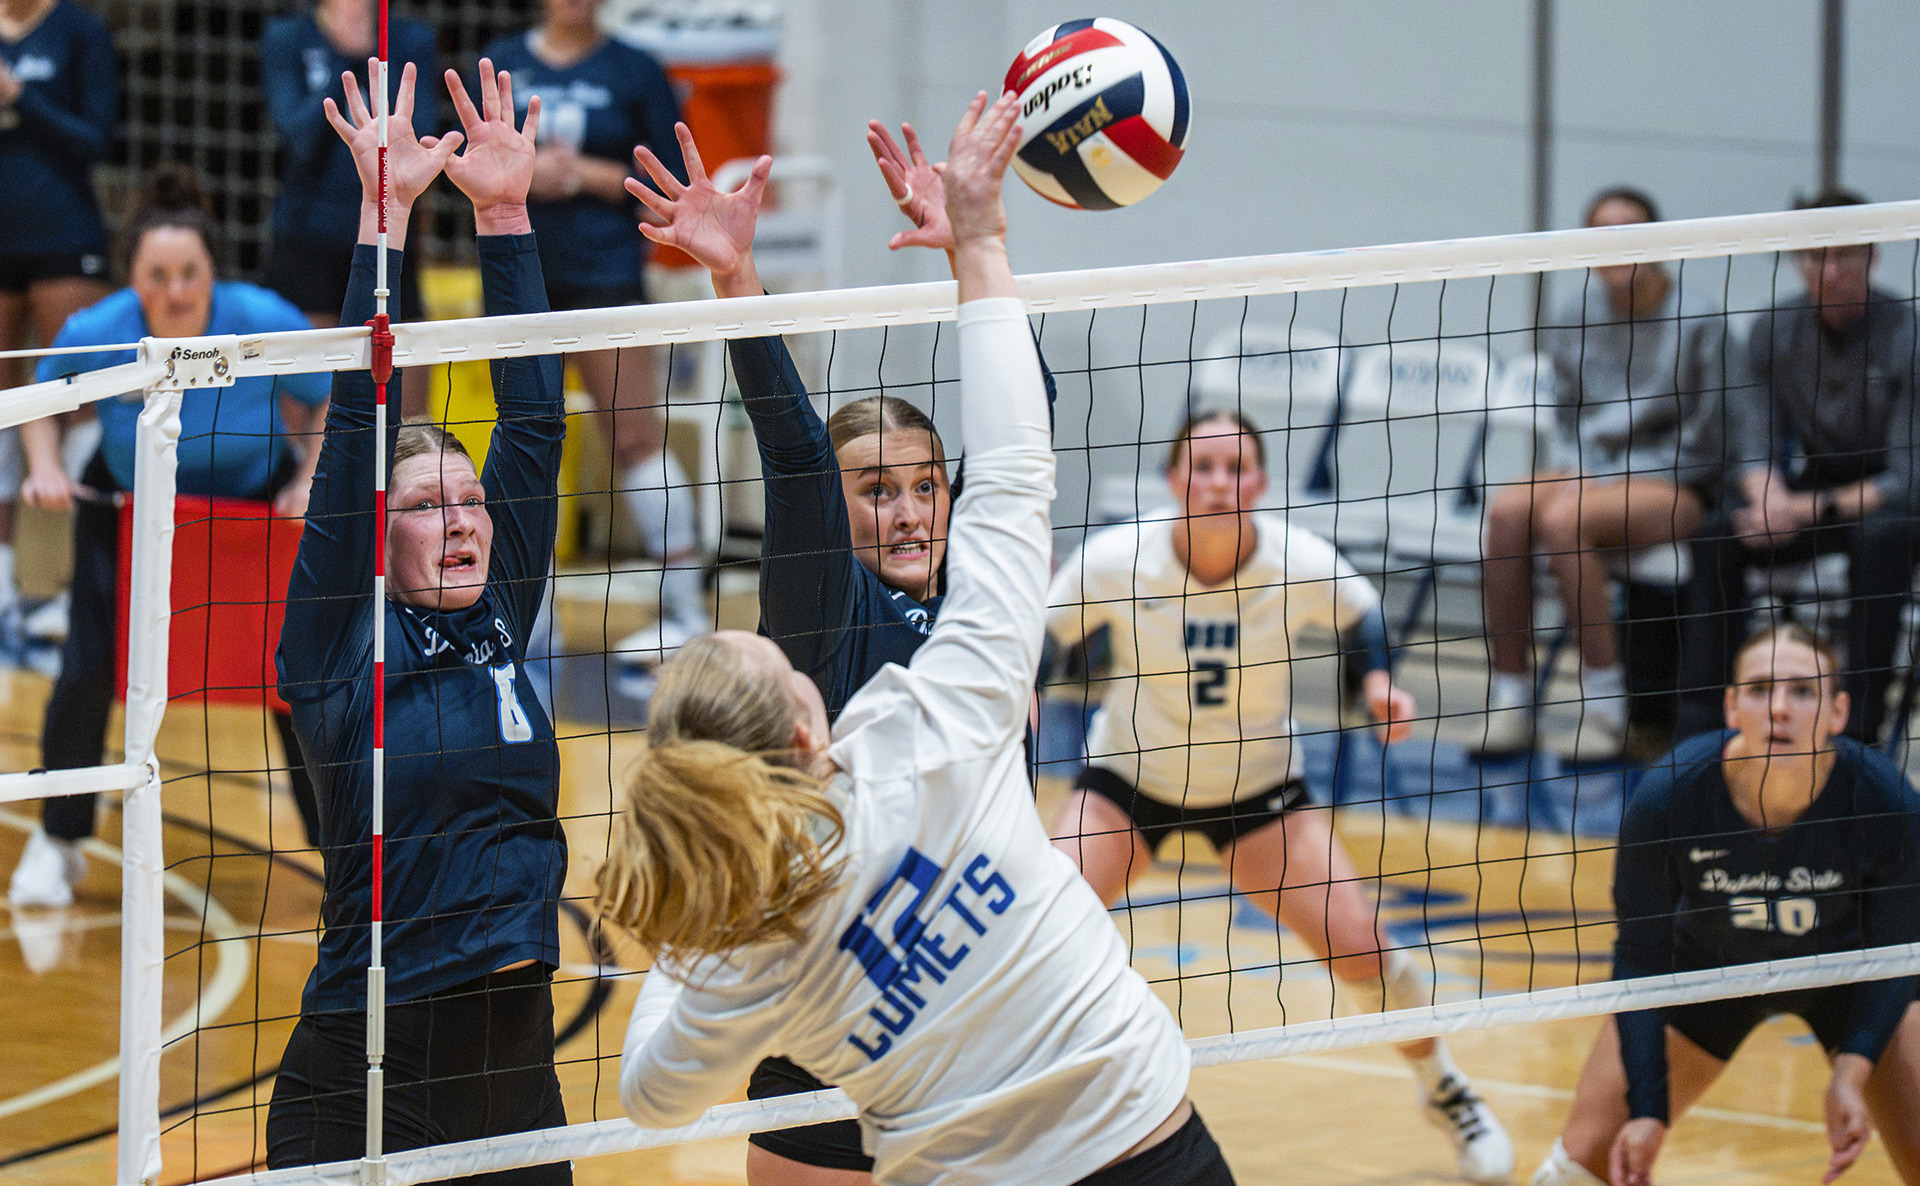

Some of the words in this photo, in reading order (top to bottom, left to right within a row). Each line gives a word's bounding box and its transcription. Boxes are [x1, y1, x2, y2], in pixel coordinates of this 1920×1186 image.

[1024, 64, 1092, 118] Baden
[1046, 95, 1113, 156] NAIA
[182, 347, 220, 360] Senoh
[487, 662, 534, 744] 8
[1195, 660, 1227, 706] 2
[1729, 896, 1820, 936] 20
